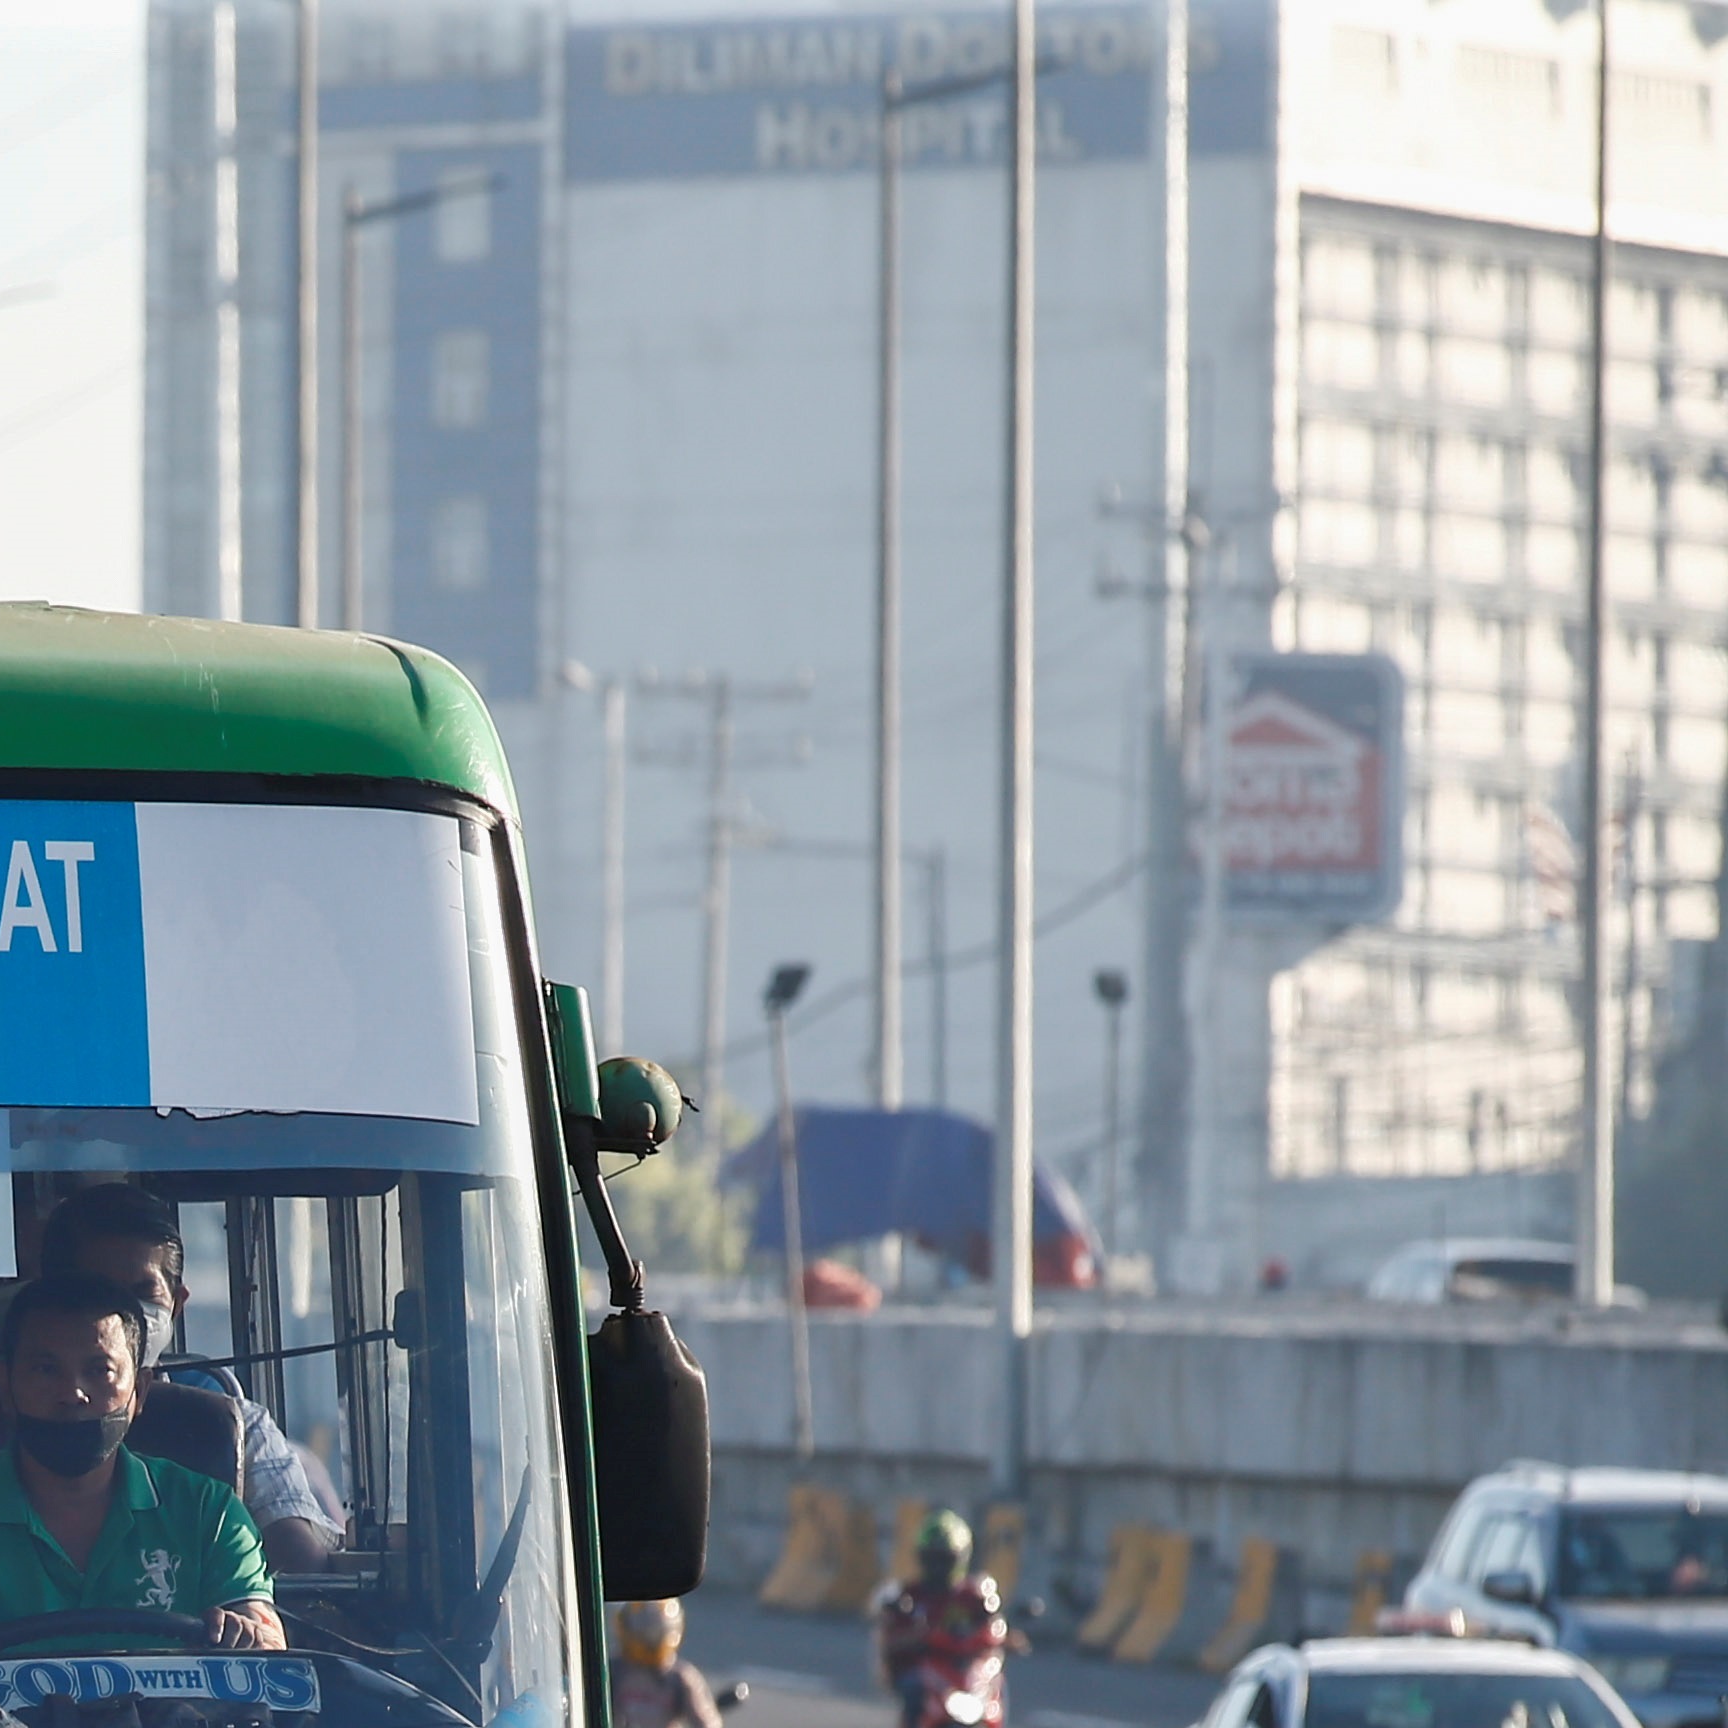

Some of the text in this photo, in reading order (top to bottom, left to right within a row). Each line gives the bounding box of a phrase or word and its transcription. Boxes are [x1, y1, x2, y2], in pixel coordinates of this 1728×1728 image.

[898, 14, 1222, 80] DOTOS
[756, 100, 1084, 167] HOPITL
[135, 1669, 204, 1690] WITH
[197, 1657, 317, 1709] US
